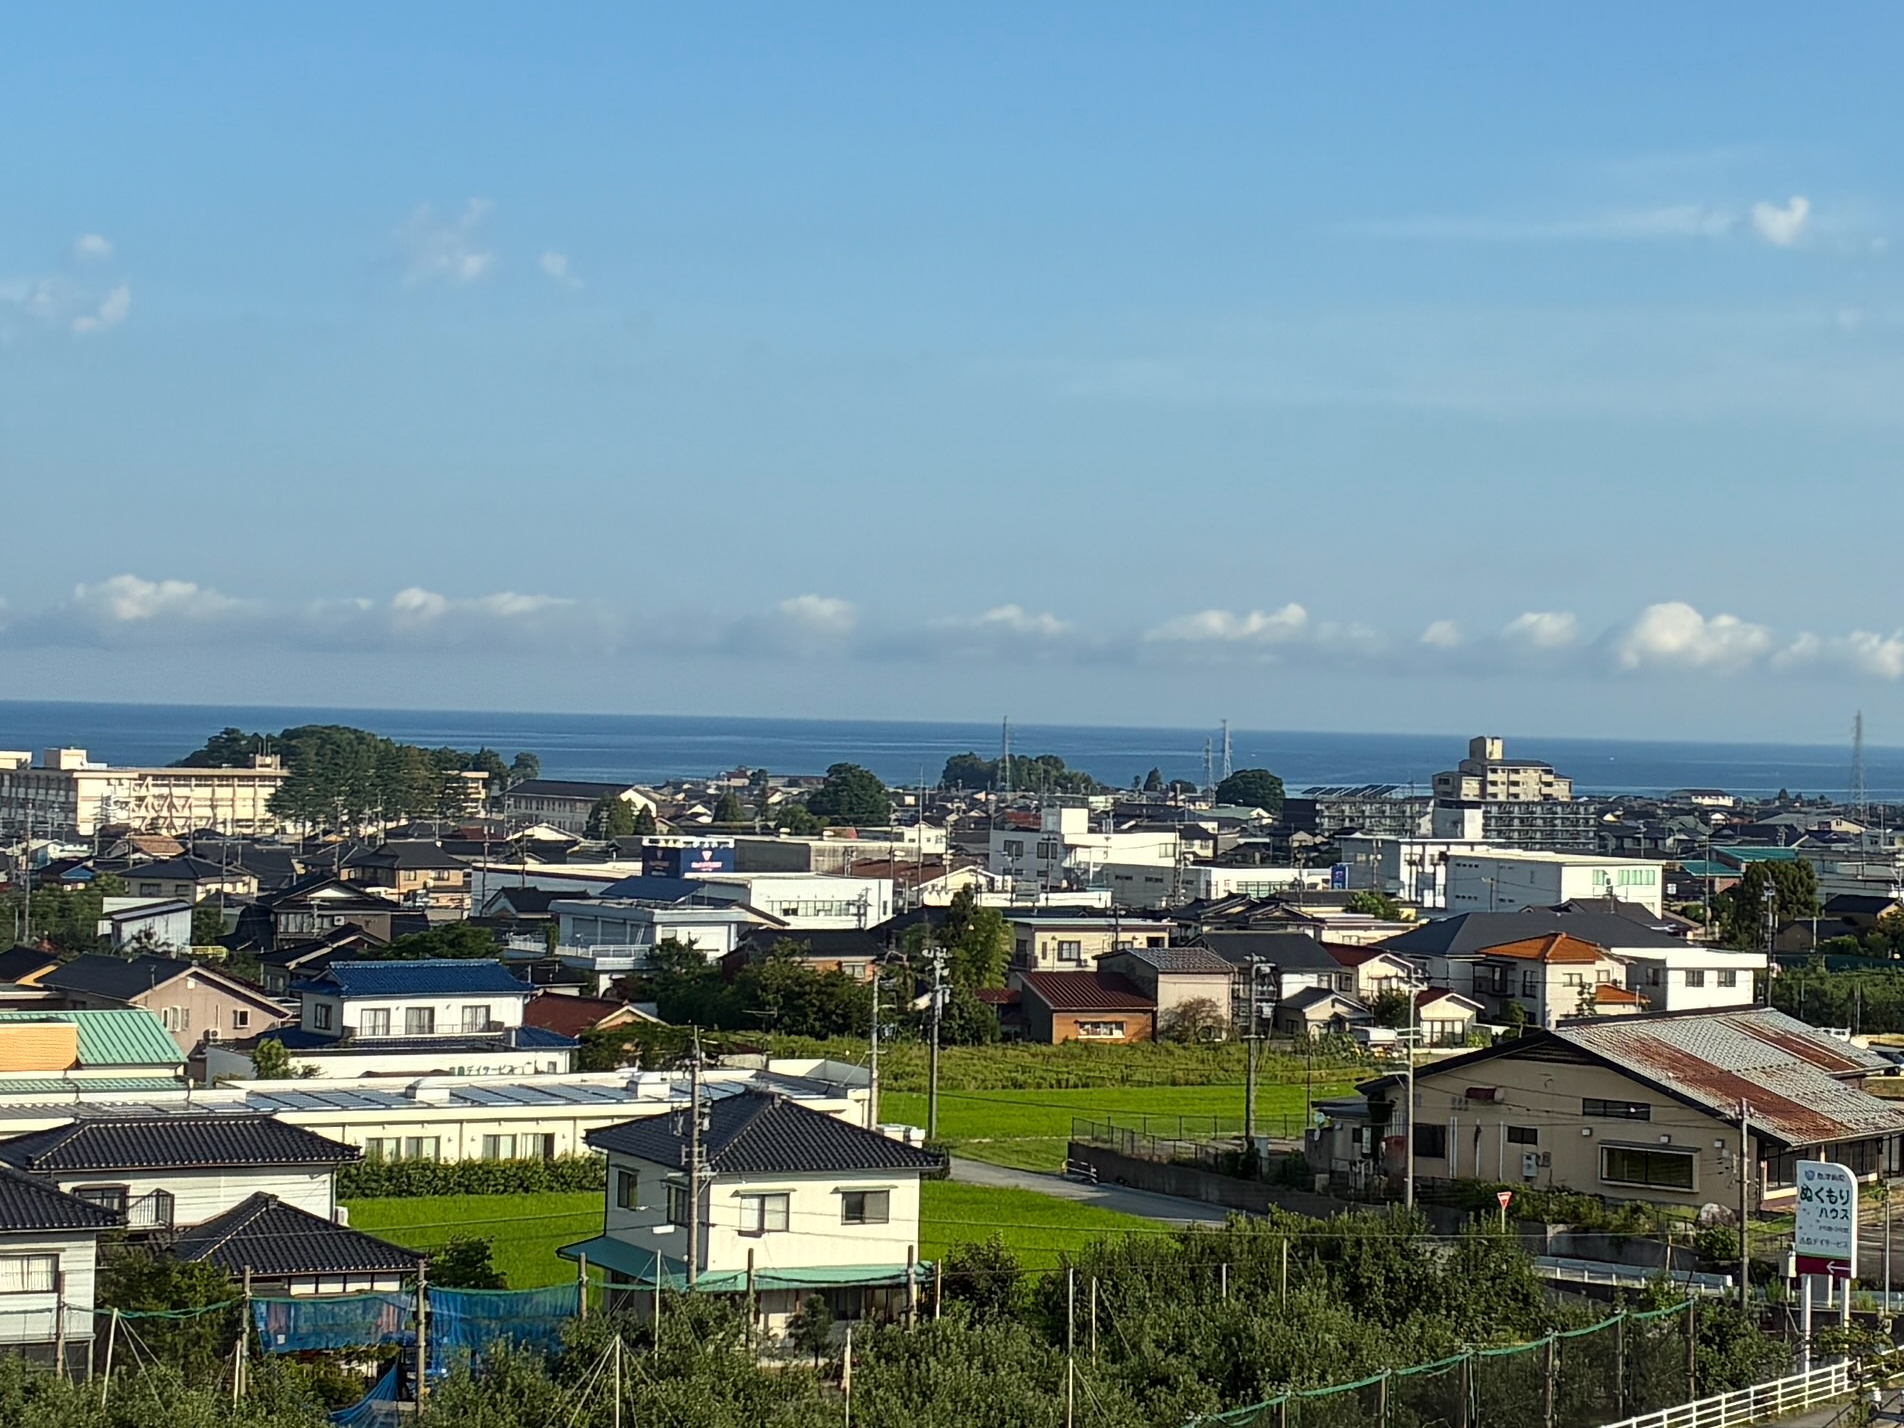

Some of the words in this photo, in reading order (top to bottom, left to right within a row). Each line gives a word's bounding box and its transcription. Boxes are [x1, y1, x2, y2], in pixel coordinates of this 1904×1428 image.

[1800, 1184, 1850, 1206] ぬくもり
[1818, 1207, 1849, 1221] ハウス
